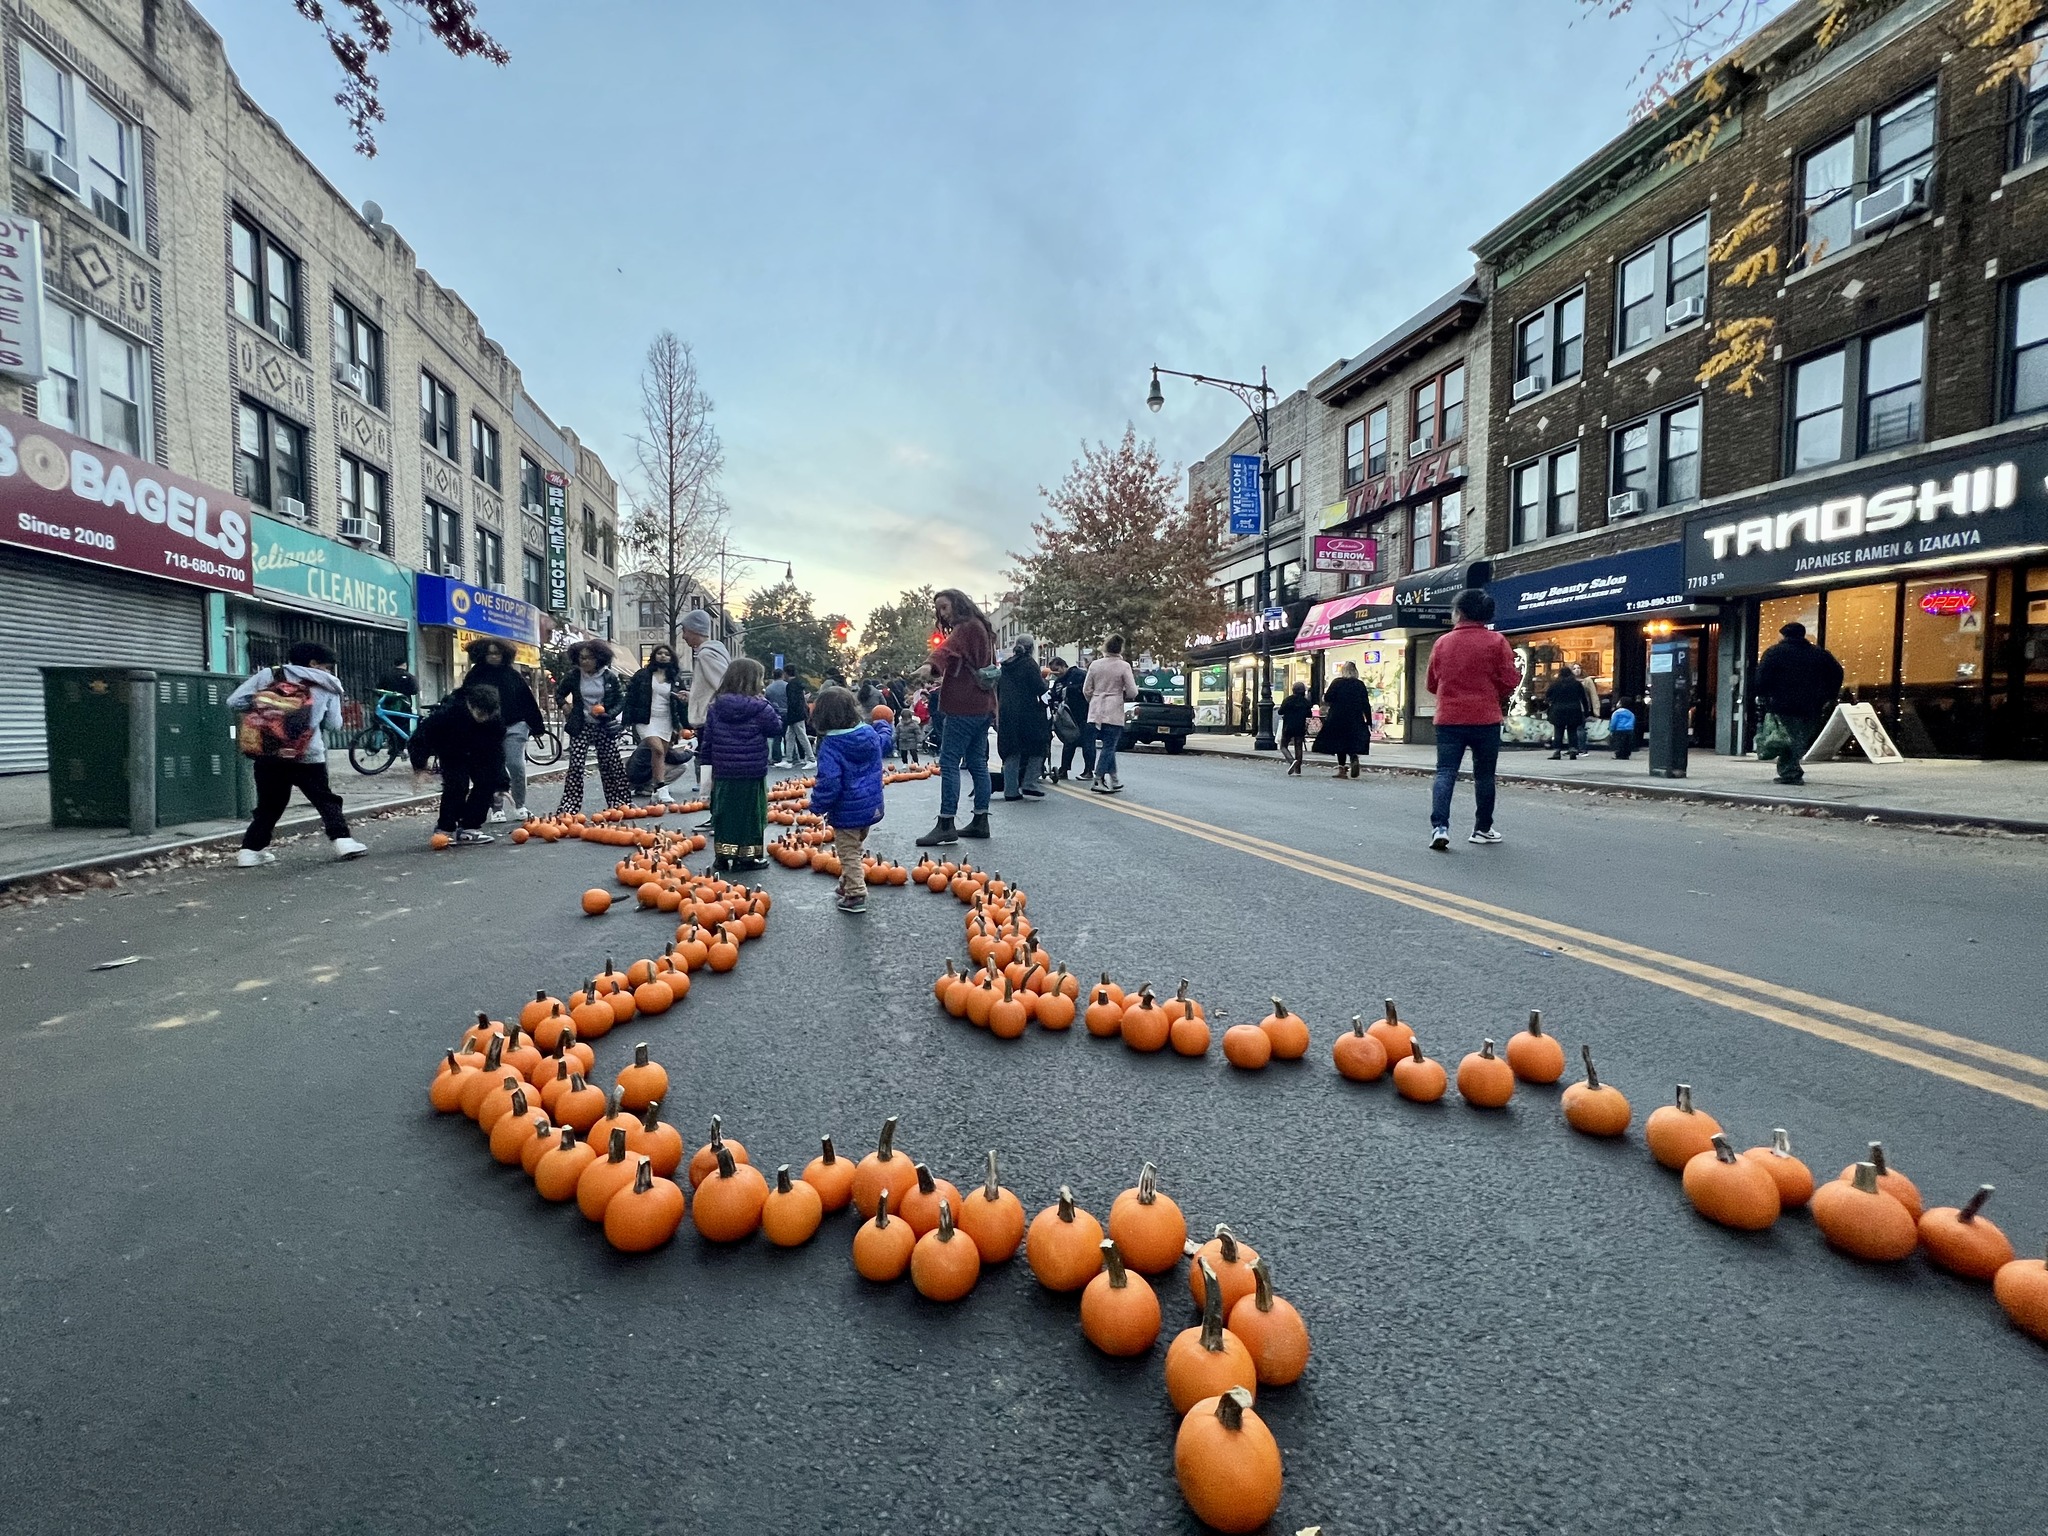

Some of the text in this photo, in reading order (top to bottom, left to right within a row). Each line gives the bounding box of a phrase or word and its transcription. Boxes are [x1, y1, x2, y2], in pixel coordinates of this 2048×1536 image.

[1233, 463, 1241, 515] WELCOME
[1347, 451, 1454, 520] TRAVEL
[70, 449, 246, 560] BAGELS
[1704, 462, 2018, 559] TANOSHII
[18, 513, 116, 551] Since 2008
[549, 487, 566, 609] BRISKET HOUSE
[164, 550, 245, 582] 718-680-5700
[251, 542, 325, 574] Reliance
[1319, 551, 1365, 560] EYEBROW
[1795, 530, 1981, 572] JAPANESE RAMEN & IZAKAYA
[307, 567, 398, 617] CLEANERS
[1434, 584, 1463, 595] ASSOCIATES
[1520, 575, 1627, 602] Tang Beauty Salon
[1687, 572, 1725, 589] 7718 5th
[474, 591, 494, 609] ONE
[495, 597, 515, 613] STOP
[1920, 594, 1976, 609] OPEN
[1226, 617, 1253, 640] Mini
[1964, 615, 1977, 627] A
[1678, 651, 1686, 664] P
